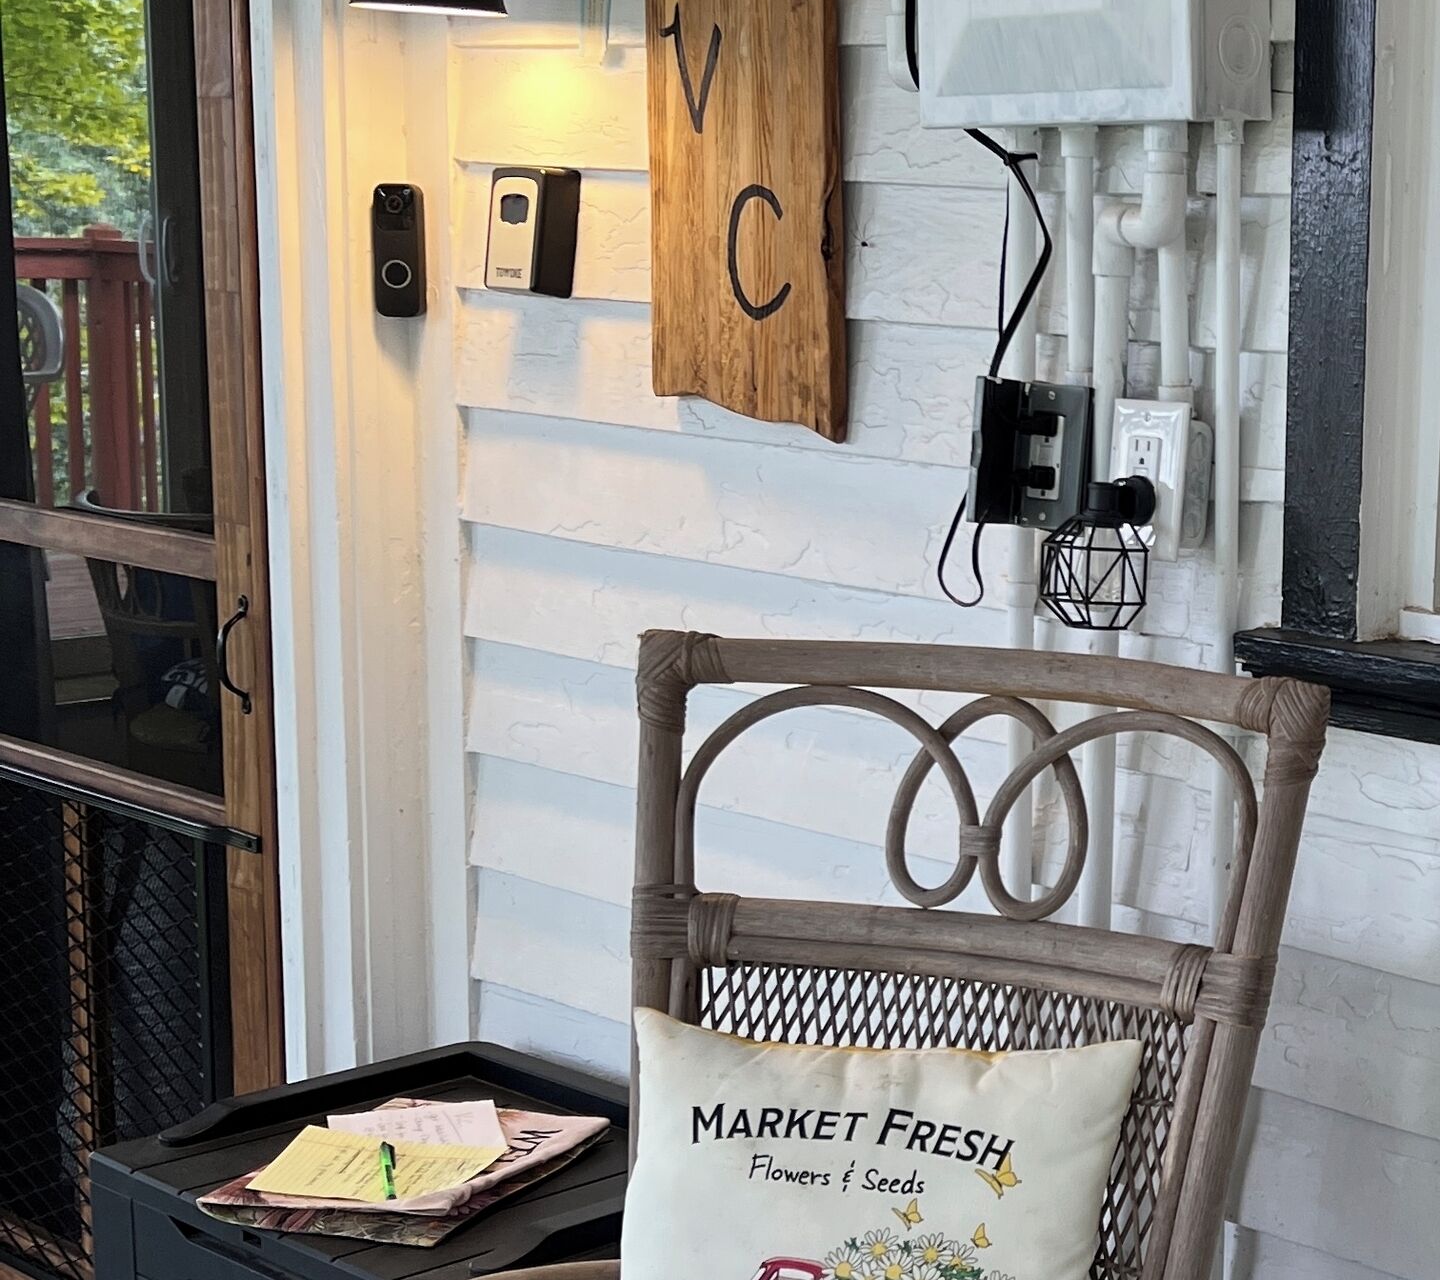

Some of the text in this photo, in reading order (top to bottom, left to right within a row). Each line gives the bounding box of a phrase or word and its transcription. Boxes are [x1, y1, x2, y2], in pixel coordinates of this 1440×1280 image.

[659, 3, 722, 134] V
[728, 184, 792, 321] C
[691, 1102, 1016, 1171] MARKET FRESH
[748, 1153, 831, 1187] Flowers
[861, 1167, 925, 1195] Seeds
